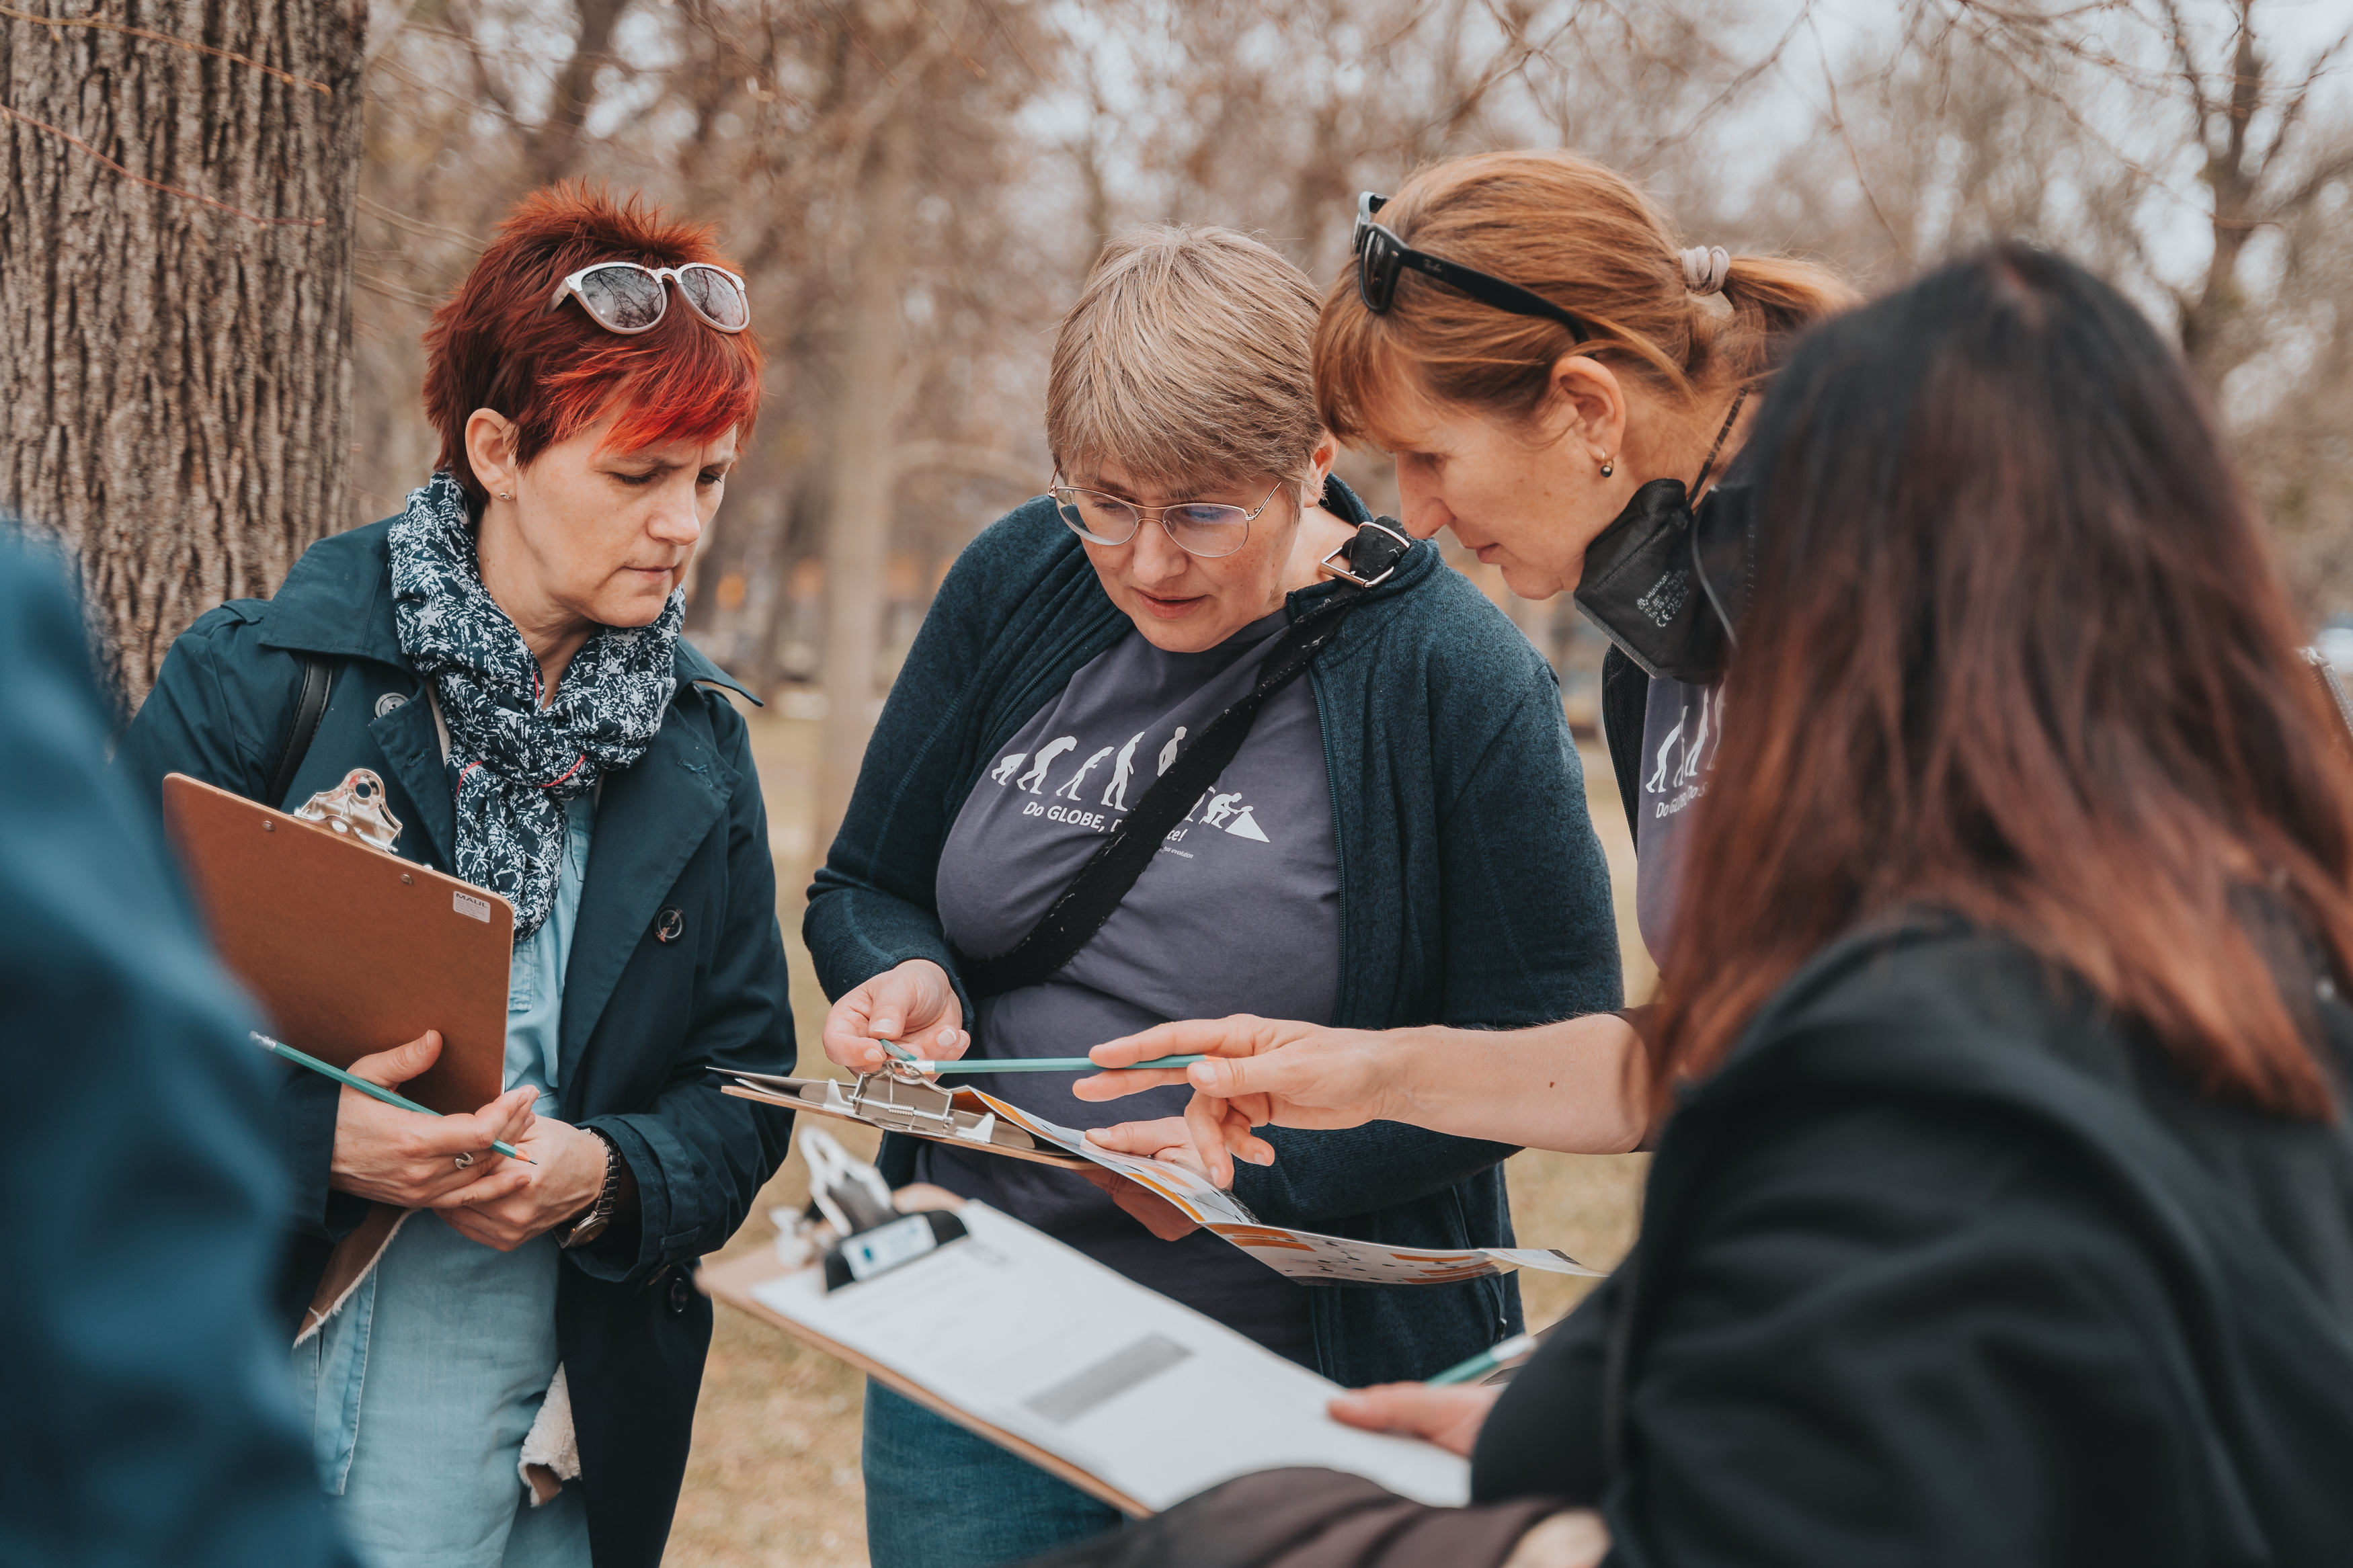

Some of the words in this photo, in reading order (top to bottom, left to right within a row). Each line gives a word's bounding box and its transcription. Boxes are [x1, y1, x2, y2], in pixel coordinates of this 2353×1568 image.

[1023, 802, 1044, 817] Do
[1047, 806, 1105, 832] GLOBE,
[1656, 802, 1669, 819] Do
[1170, 849, 1194, 859] evolution
[456, 893, 488, 908] MAUL
